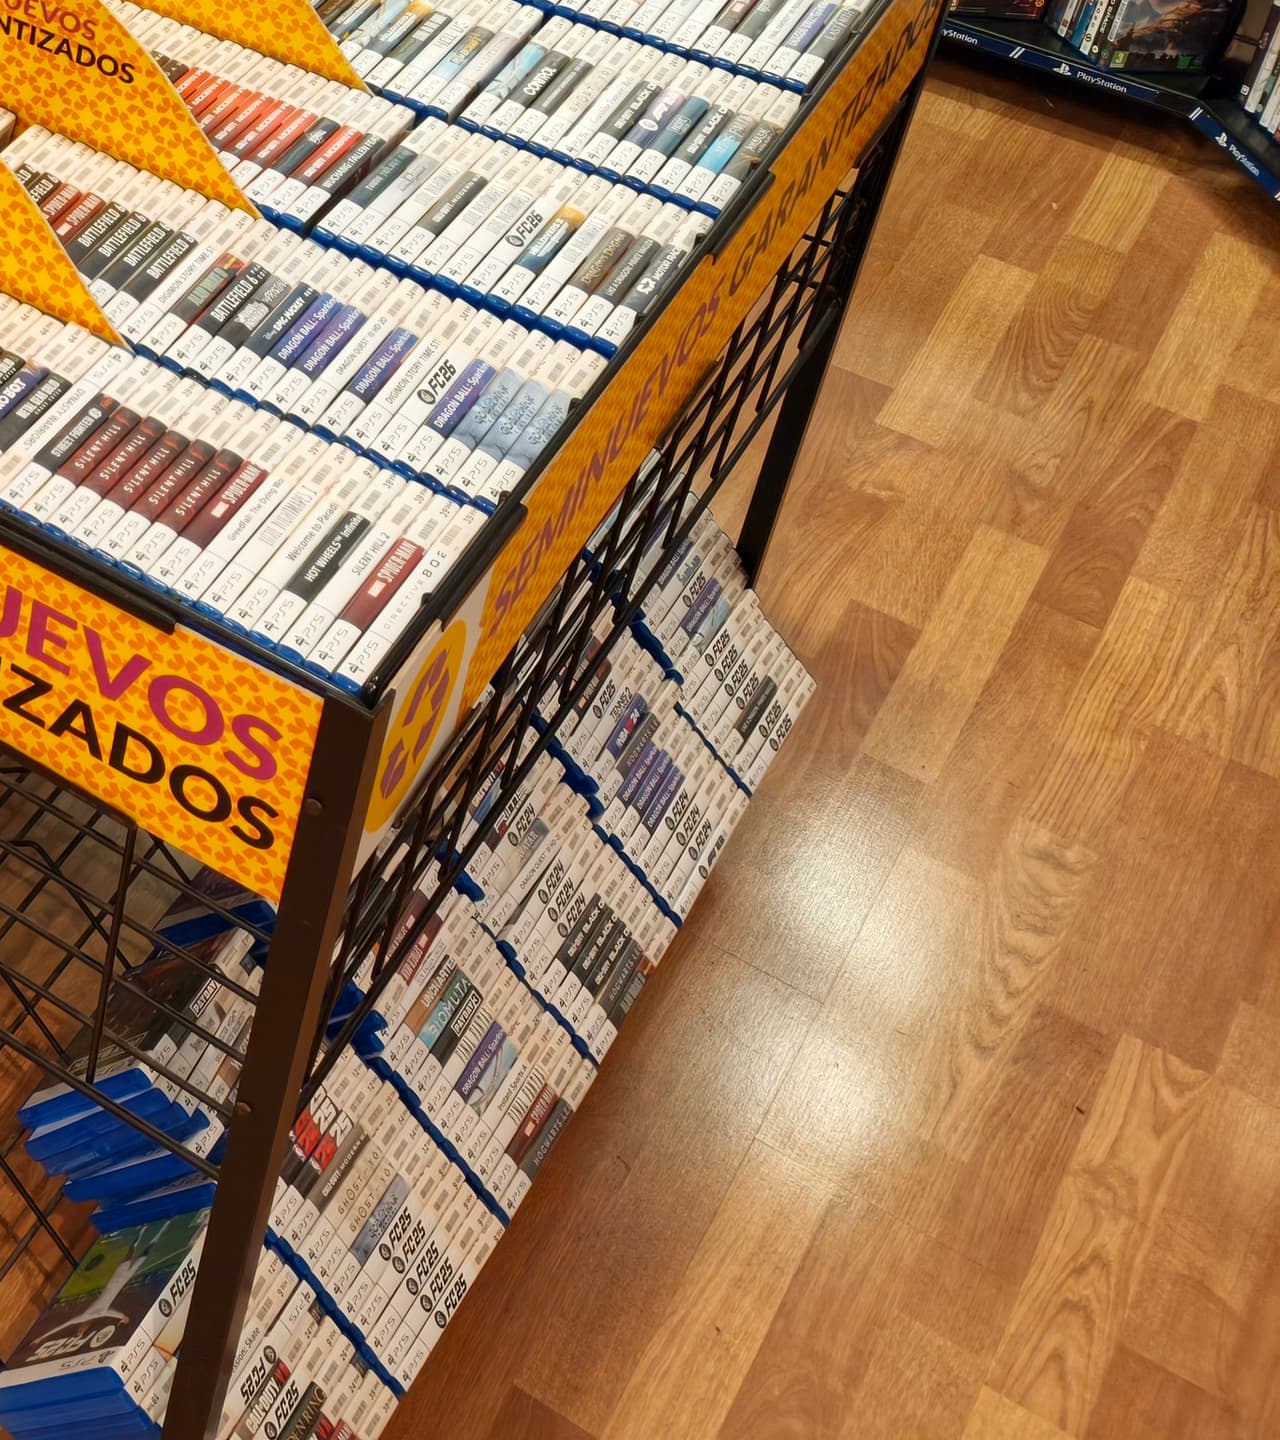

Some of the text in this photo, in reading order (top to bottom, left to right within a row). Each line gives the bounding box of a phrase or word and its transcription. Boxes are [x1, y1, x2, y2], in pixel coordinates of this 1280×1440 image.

[214, 283, 252, 323] BATTLEFIELD
[2, 376, 27, 402] BOT
[429, 359, 457, 392] FC26
[76, 423, 122, 470] SILENT HILL
[444, 1274, 467, 1317] FC25
